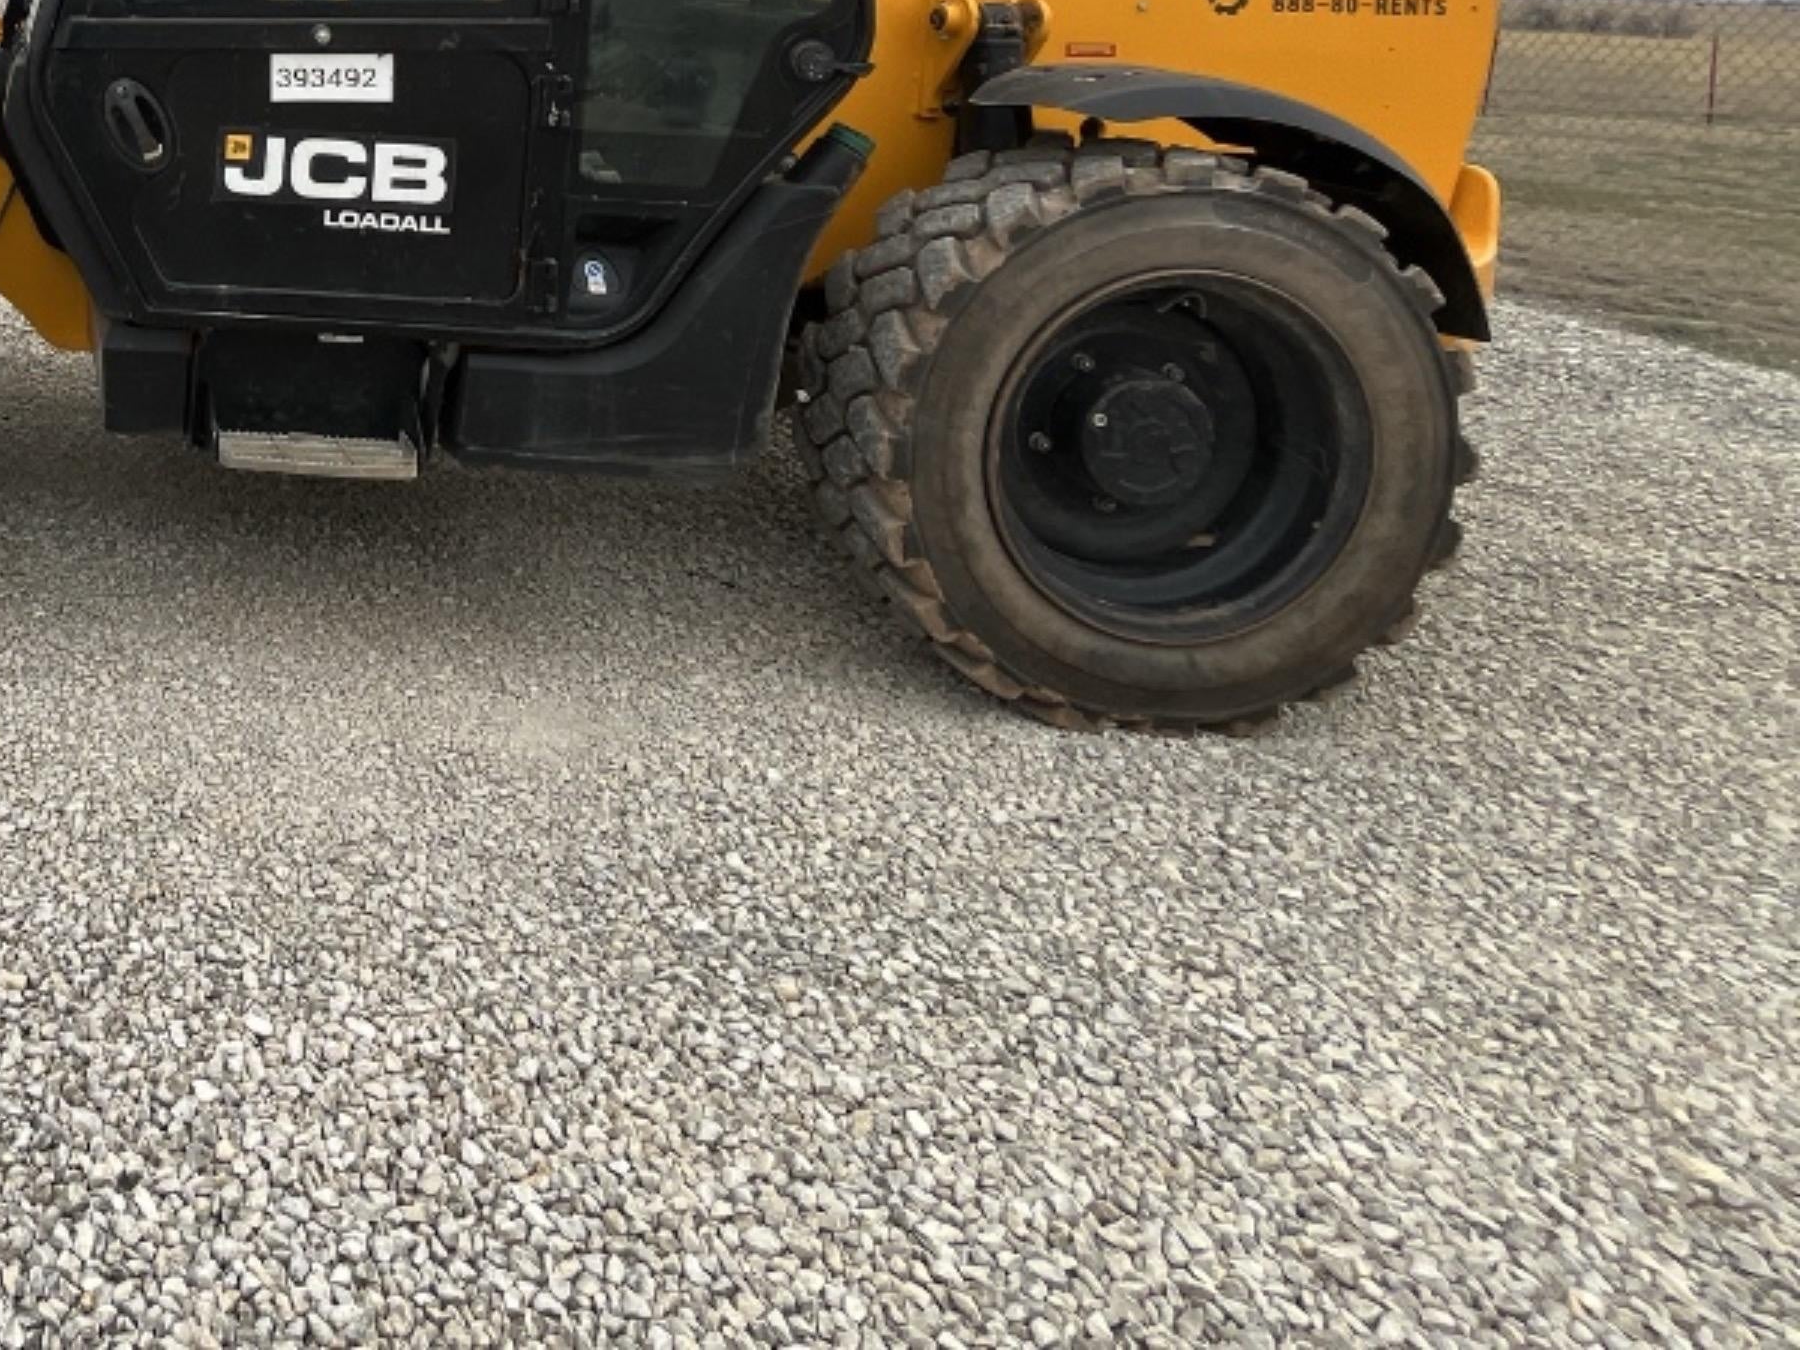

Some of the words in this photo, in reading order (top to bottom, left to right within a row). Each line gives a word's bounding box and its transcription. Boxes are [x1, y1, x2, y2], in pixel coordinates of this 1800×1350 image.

[276, 67, 377, 88] 393492
[224, 136, 448, 205] JCB
[323, 209, 450, 234] LOADALL
